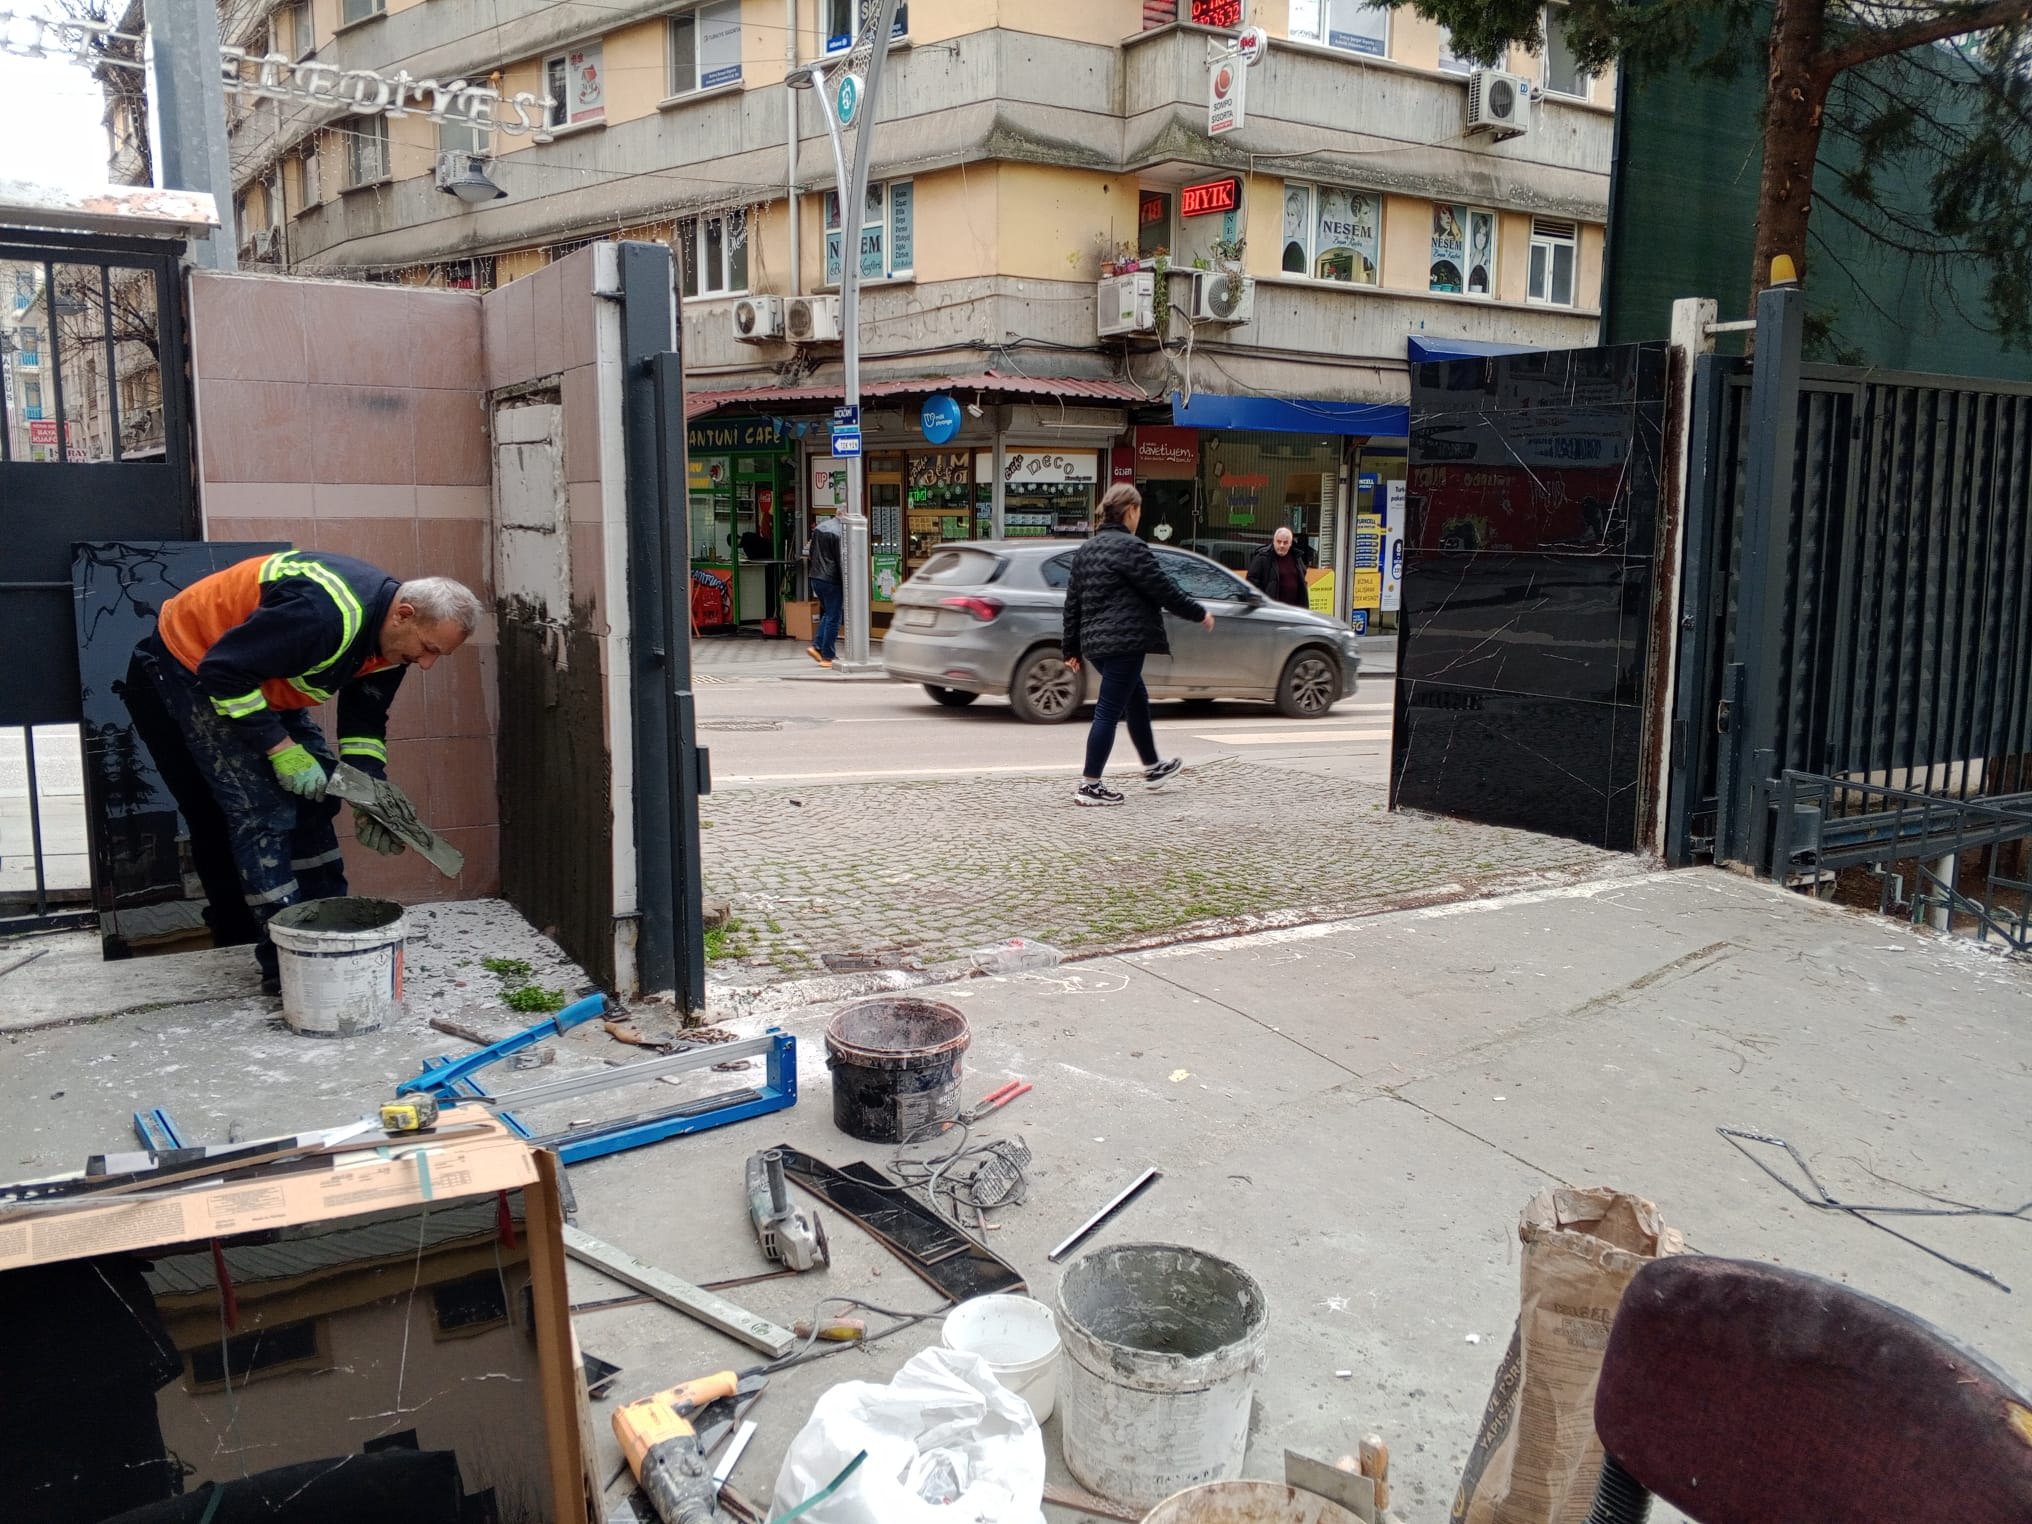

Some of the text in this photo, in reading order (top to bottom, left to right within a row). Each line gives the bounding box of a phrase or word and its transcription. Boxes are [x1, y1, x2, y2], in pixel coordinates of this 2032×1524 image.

[1213, 98, 1233, 111] SOMPO
[1183, 185, 1232, 211] BIYIK
[1323, 220, 1373, 239] NESEM
[830, 235, 881, 259] NEM
[1432, 237, 1462, 251] NESEM
[688, 424, 738, 447] ANTUNİ
[1500, 1358, 1522, 1396] PORS
